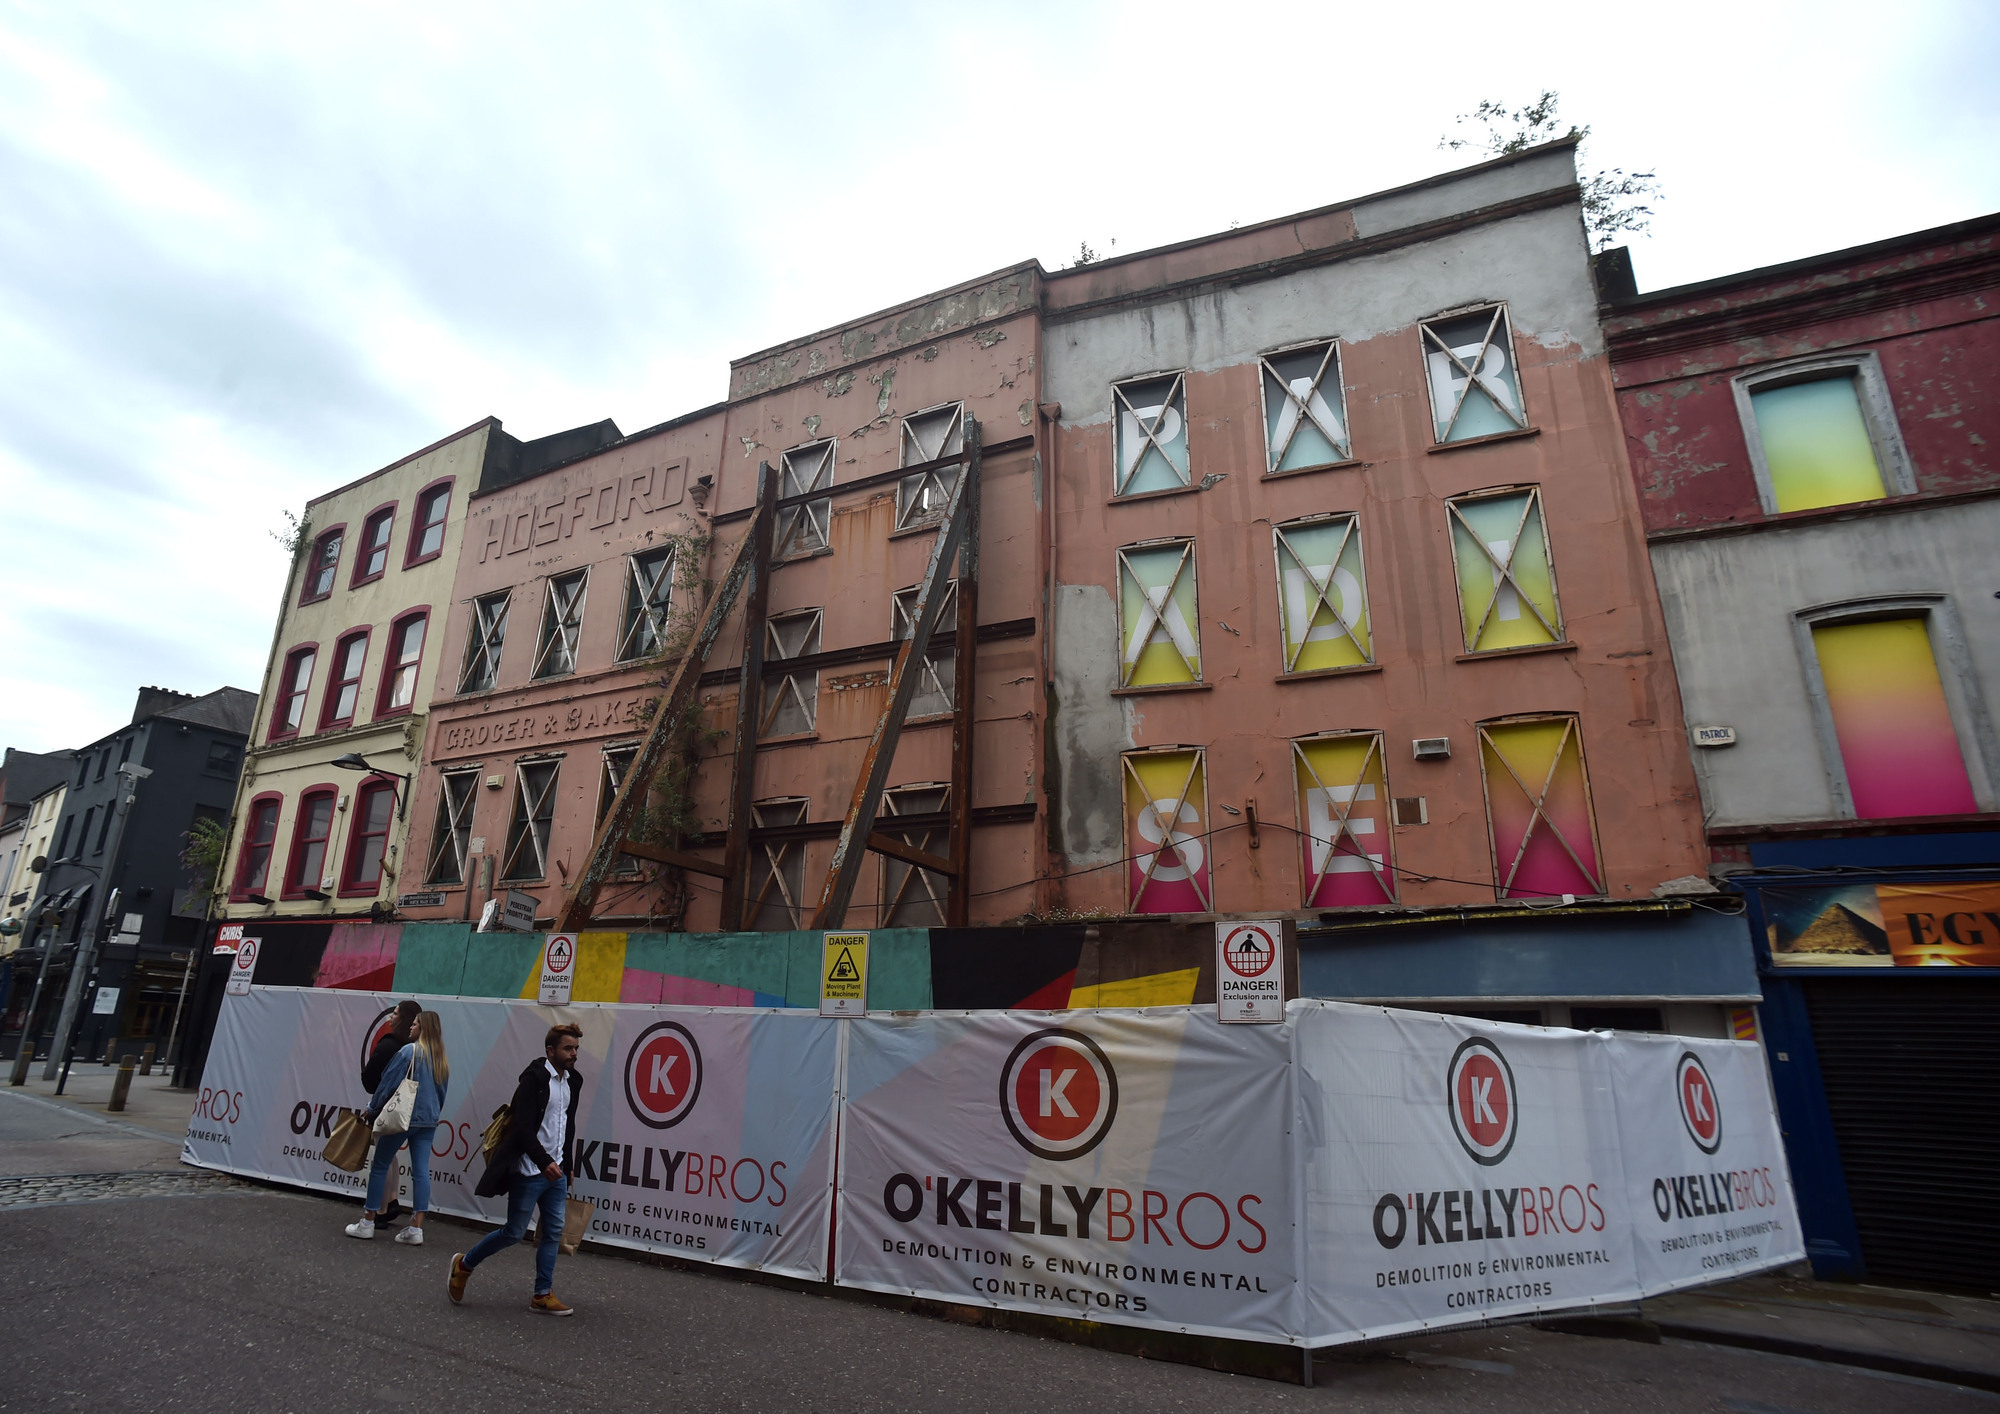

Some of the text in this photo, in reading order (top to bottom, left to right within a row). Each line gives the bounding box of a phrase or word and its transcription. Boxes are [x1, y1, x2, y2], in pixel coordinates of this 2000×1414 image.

[1121, 342, 1517, 475] P A R
[479, 456, 689, 564] HOSFORD
[1125, 585, 1198, 663] A
[1284, 564, 1363, 645] D
[444, 714, 537, 750] GROCER
[543, 713, 558, 736] &
[1699, 728, 1731, 739] PATROL
[1136, 783, 1384, 882] S E
[506, 908, 533, 922] PRIORITY ZONE
[510, 900, 532, 913] PEDESTRIAN
[220, 926, 244, 940] CHRIS
[828, 936, 864, 946] DANGER
[543, 975, 570, 983] DANGER!
[831, 990, 859, 998] Machinery
[1223, 981, 1278, 991] DANGER!
[649, 1054, 679, 1096] K
[1039, 1068, 1080, 1118] K
[1471, 1076, 1499, 1124] K
[1689, 1083, 1711, 1122] K
[574, 1138, 787, 1207] KELLYBROS
[592, 1219, 706, 1249] CONTRACTORS
[627, 1202, 637, 1214] &
[643, 1205, 783, 1237] ENVIRONMENTAL
[1661, 1219, 1783, 1253] DEMOLITION & ENVIRONMENTAL
[882, 1239, 1268, 1294] DEMOLITION & ENVIRONMENTAL
[1376, 1249, 1611, 1288] DEMOLITION & ENVIRONMENTAL
[1702, 1246, 1759, 1269] CONTRACTORS
[972, 1277, 1148, 1312] CONTRACTORS
[1446, 1281, 1553, 1308] CONTRACTORS
